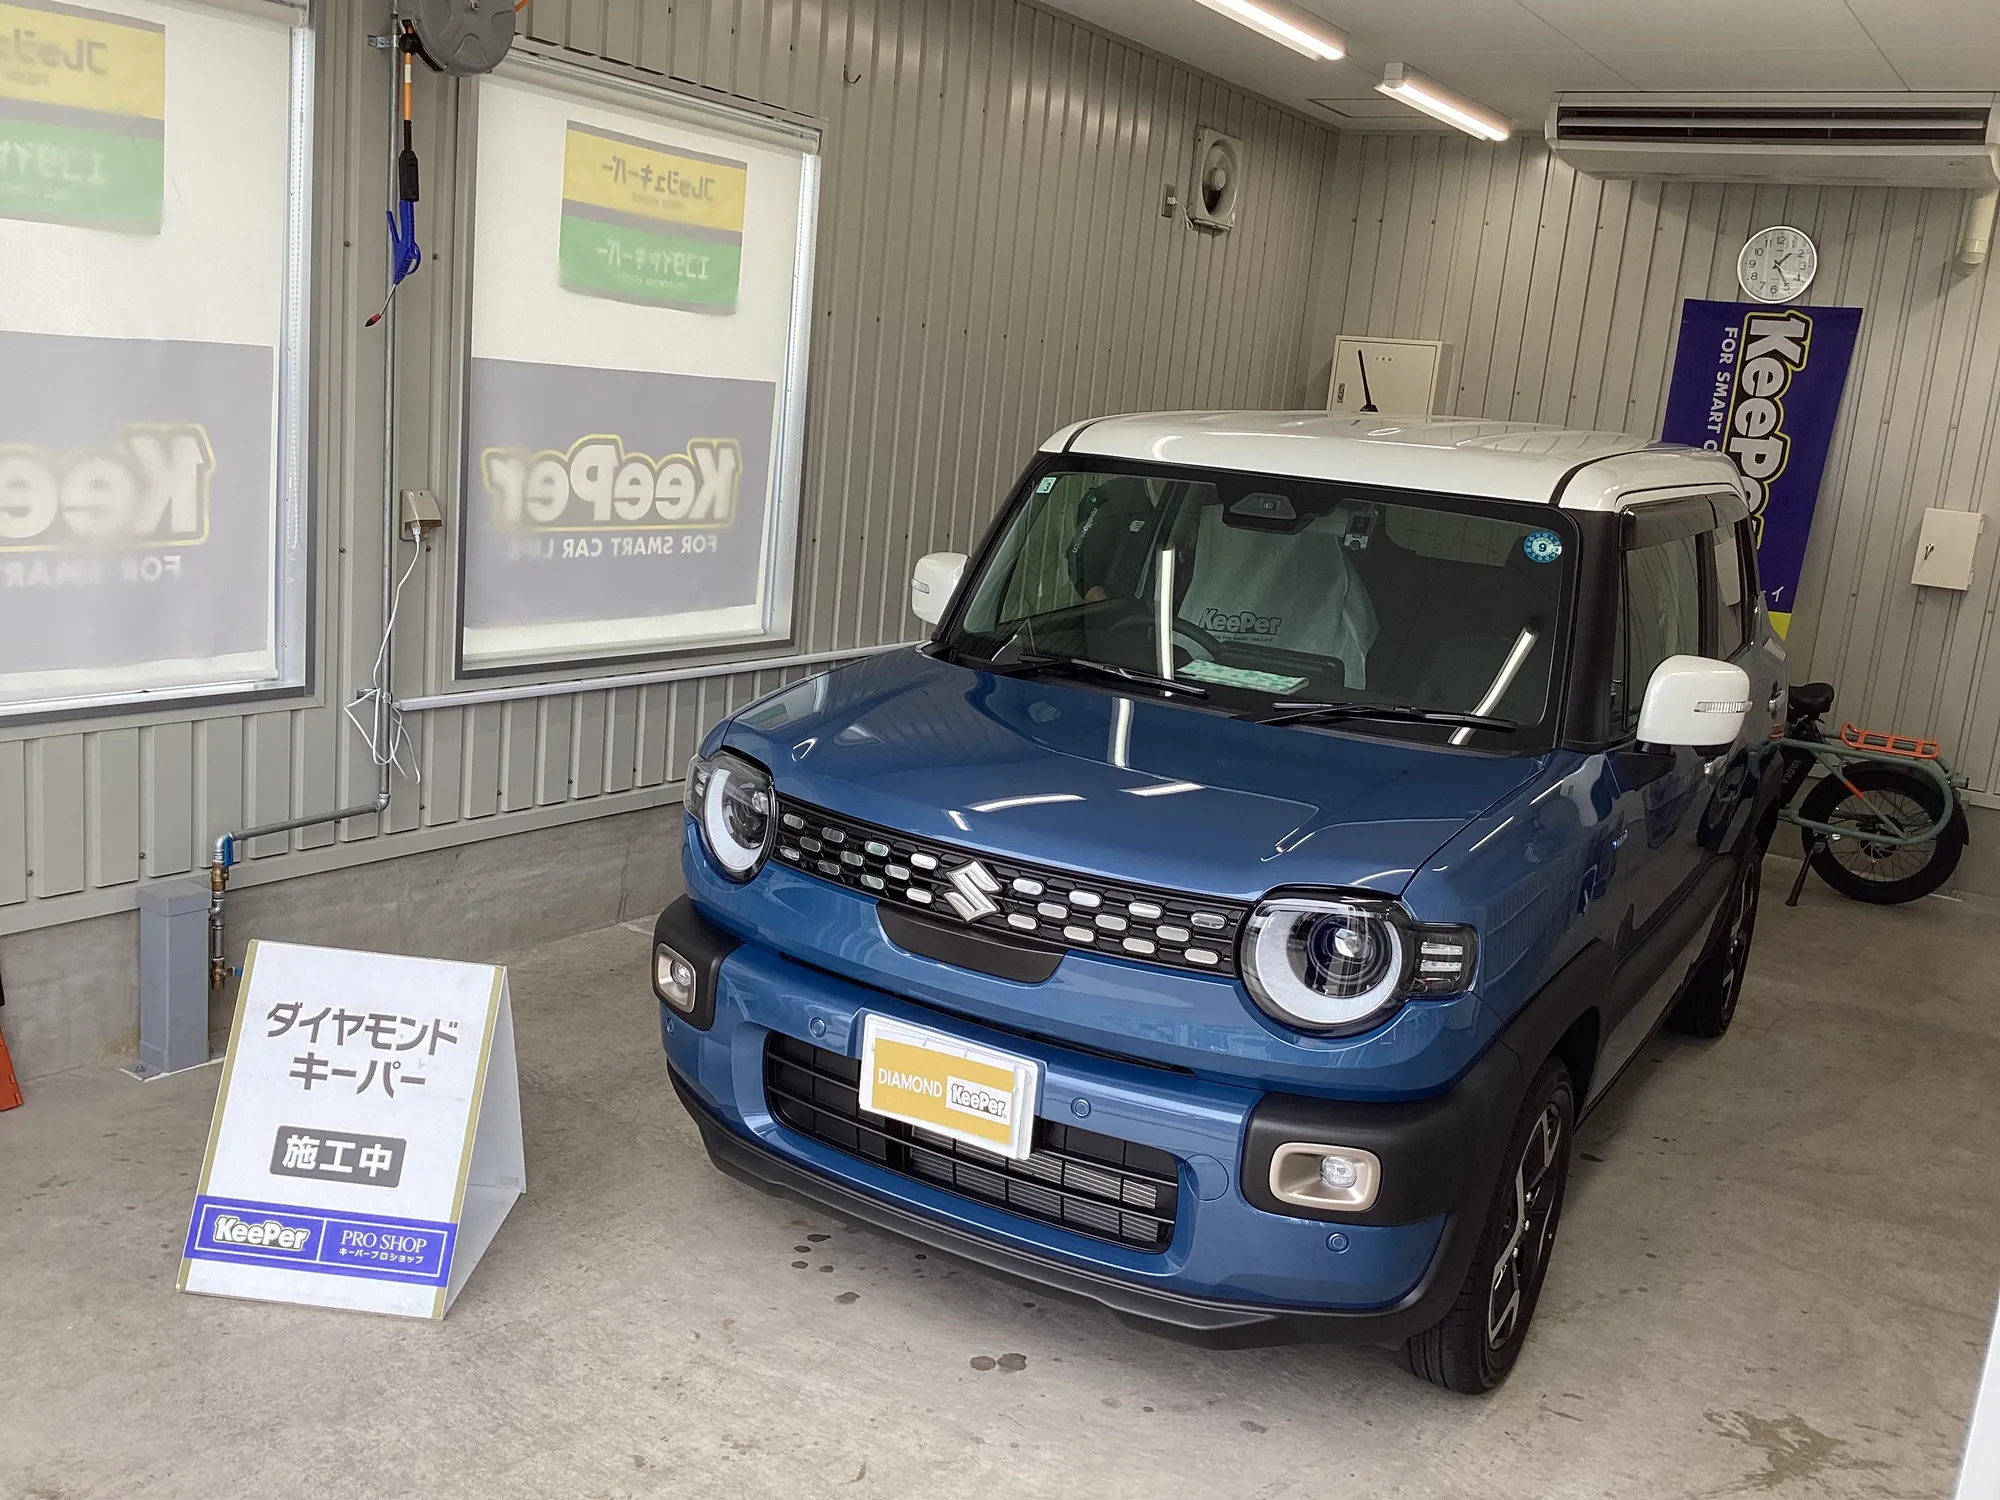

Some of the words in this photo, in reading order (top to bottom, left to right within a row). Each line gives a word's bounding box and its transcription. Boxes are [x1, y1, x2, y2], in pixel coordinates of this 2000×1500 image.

[1765, 239, 1772, 248] 11
[1777, 236, 1786, 245] 12
[1755, 248, 1764, 256] 10
[1797, 249, 1804, 257] 2
[1749, 260, 1756, 268] 9
[1800, 262, 1806, 270] 3
[1751, 272, 1758, 281] 8
[1760, 281, 1766, 290] 7
[1770, 285, 1778, 294] 6
[1718, 326, 1739, 364] FOR
[1706, 371, 1731, 434] SMART
[1729, 316, 1806, 534] KeeP
[1043, 483, 1051, 492] 3
[1538, 542, 1547, 553] 9
[1199, 607, 1282, 635] KeePer
[265, 1001, 458, 1056] ダイヤモンド
[288, 1051, 427, 1099] キーパー
[877, 1067, 943, 1098] DIAMOND
[951, 1083, 1006, 1118] KeePer
[281, 1134, 393, 1178] 施工中
[214, 1215, 309, 1250] KeePer
[340, 1229, 377, 1249] PRO
[379, 1233, 428, 1254] SHOP
